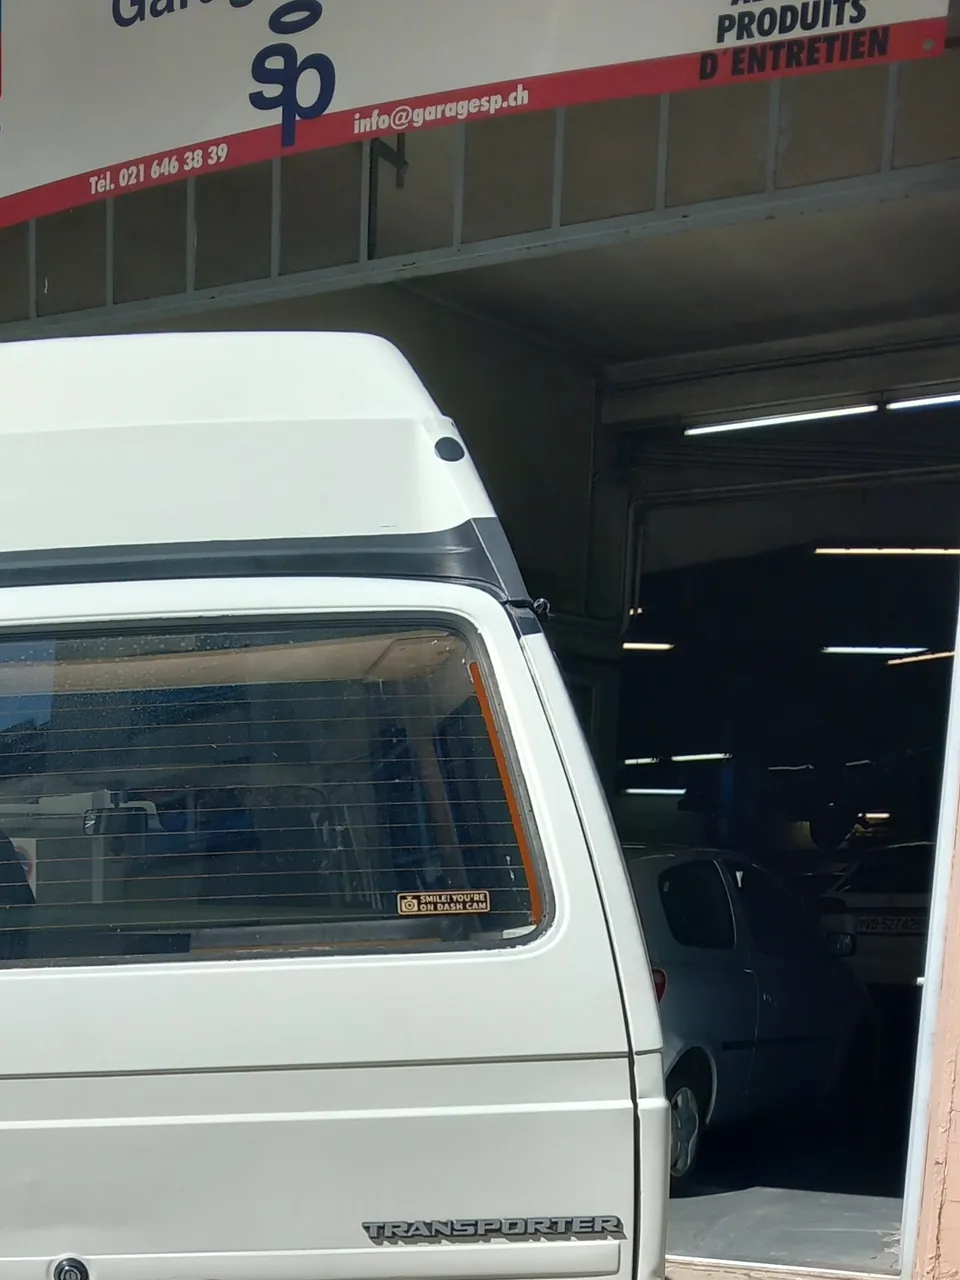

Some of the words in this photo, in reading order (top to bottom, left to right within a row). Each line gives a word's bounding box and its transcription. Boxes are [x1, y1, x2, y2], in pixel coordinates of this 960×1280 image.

[716, 0, 866, 43] PRODUITS
[353, 83, 530, 135] info@garagesp.ch
[89, 171, 115, 195] Tél.
[119, 163, 145, 187] 021
[150, 155, 179, 179] 646
[183, 149, 203, 171] 38
[207, 143, 228, 165] 39
[420, 895, 451, 903] SMILE!
[452, 893, 485, 902] YOU'RE
[437, 903, 463, 911] DASH
[466, 902, 486, 910] CAM
[362, 1216, 622, 1238] TRANSPORTER
